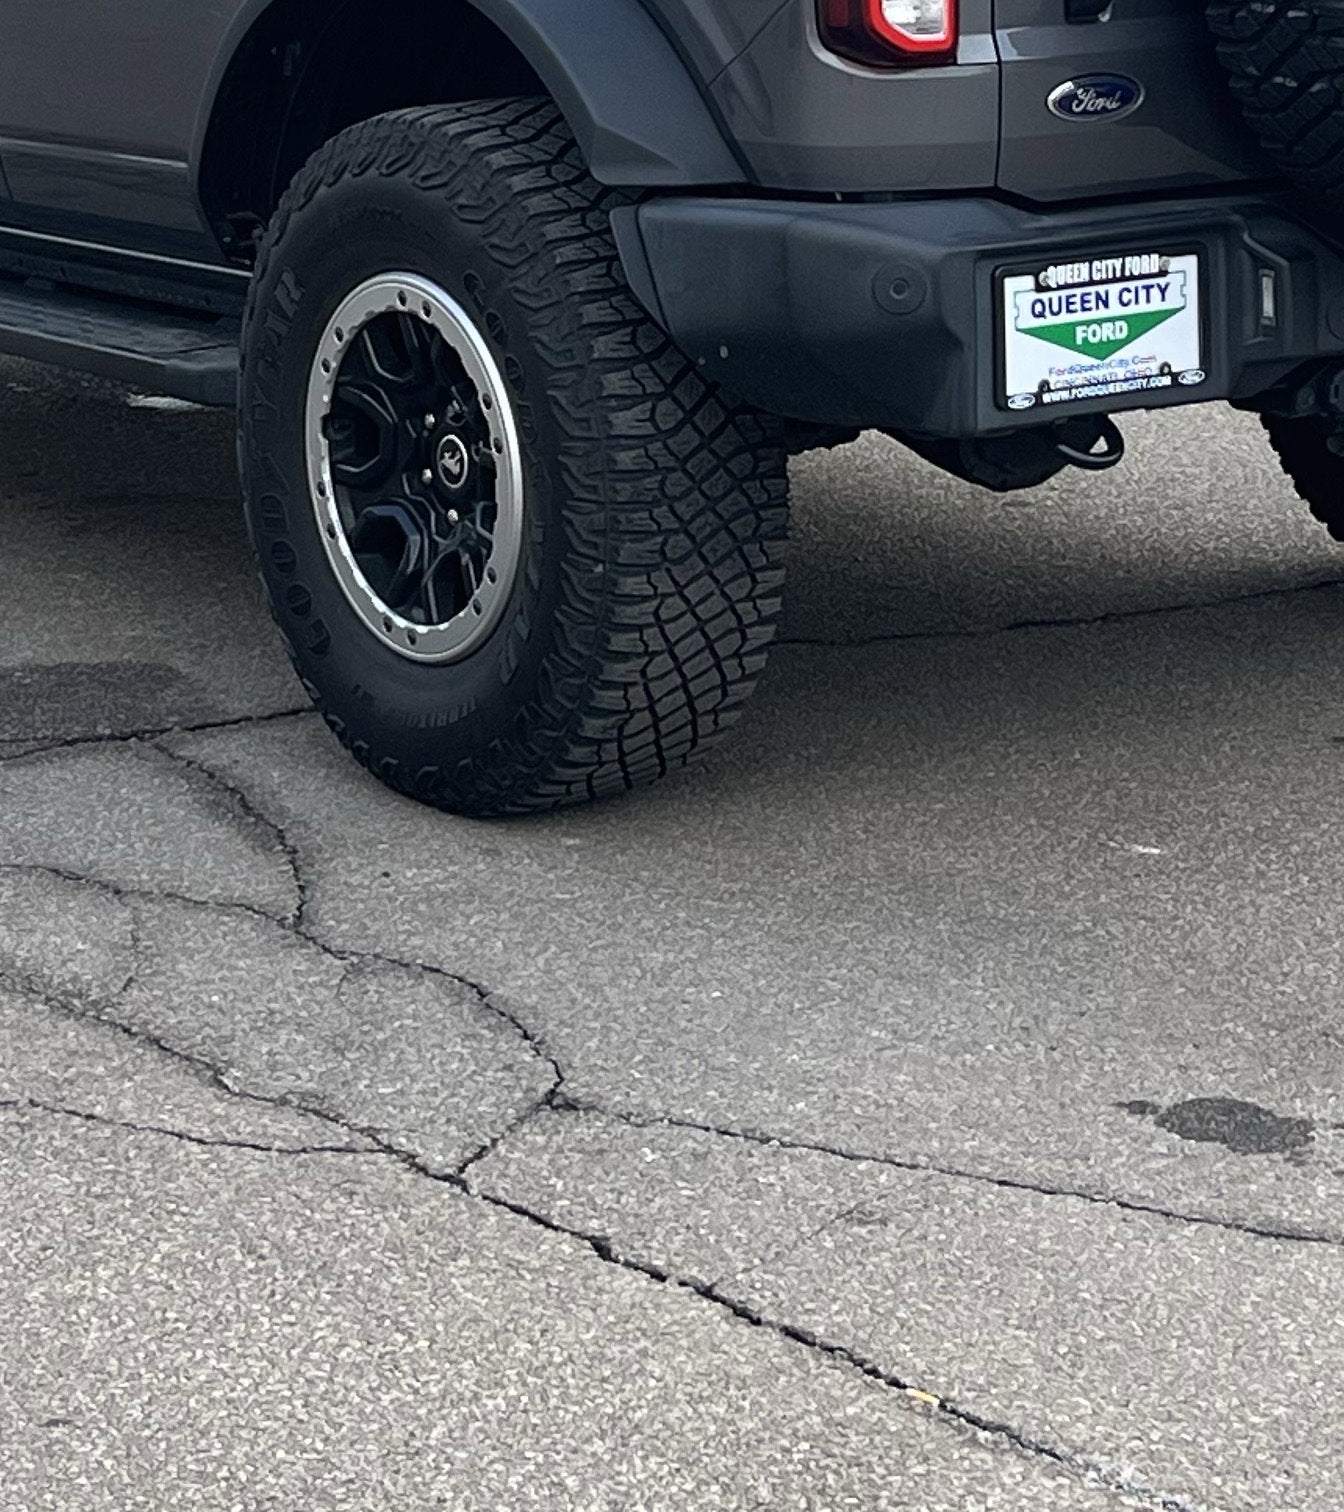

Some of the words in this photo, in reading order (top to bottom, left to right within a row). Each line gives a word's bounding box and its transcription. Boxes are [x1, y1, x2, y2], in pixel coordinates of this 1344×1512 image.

[1071, 87, 1123, 113] Ford
[1046, 261, 1090, 288] QUEEN
[1091, 256, 1123, 281] CITY
[1124, 252, 1160, 277] FORD
[1030, 288, 1111, 320] QUEEN
[1117, 282, 1172, 308] CITY
[1074, 320, 1129, 346] FORD
